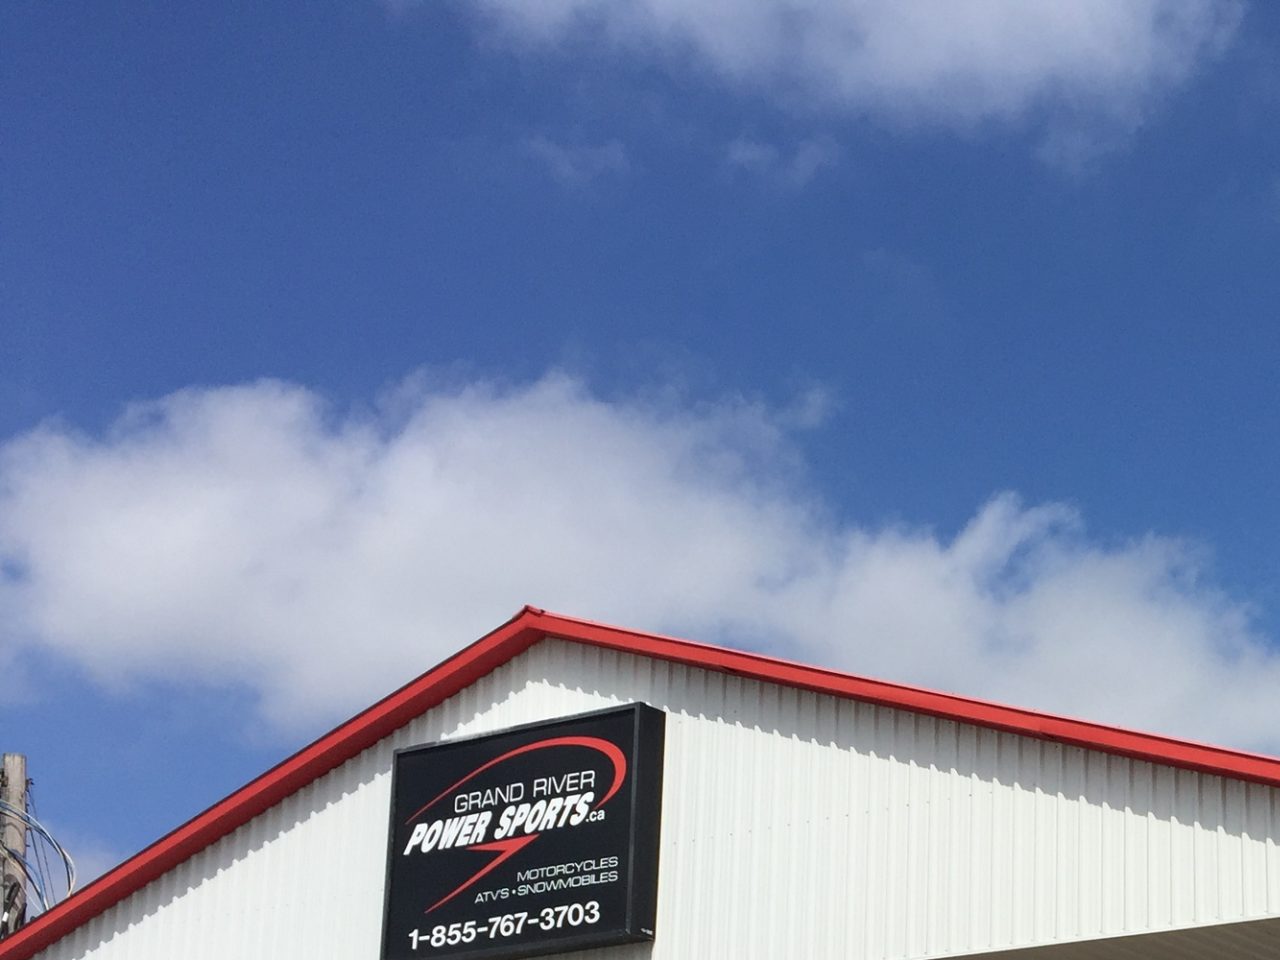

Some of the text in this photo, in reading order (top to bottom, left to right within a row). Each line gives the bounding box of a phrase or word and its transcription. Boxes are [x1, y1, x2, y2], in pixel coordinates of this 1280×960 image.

[454, 770, 596, 814] GRAND RIVER
[403, 803, 493, 856] POWER
[516, 856, 619, 883] MOTORCYCLES
[517, 870, 619, 897] SNOWMOBILES
[408, 901, 601, 950] 1-855-767-3703
